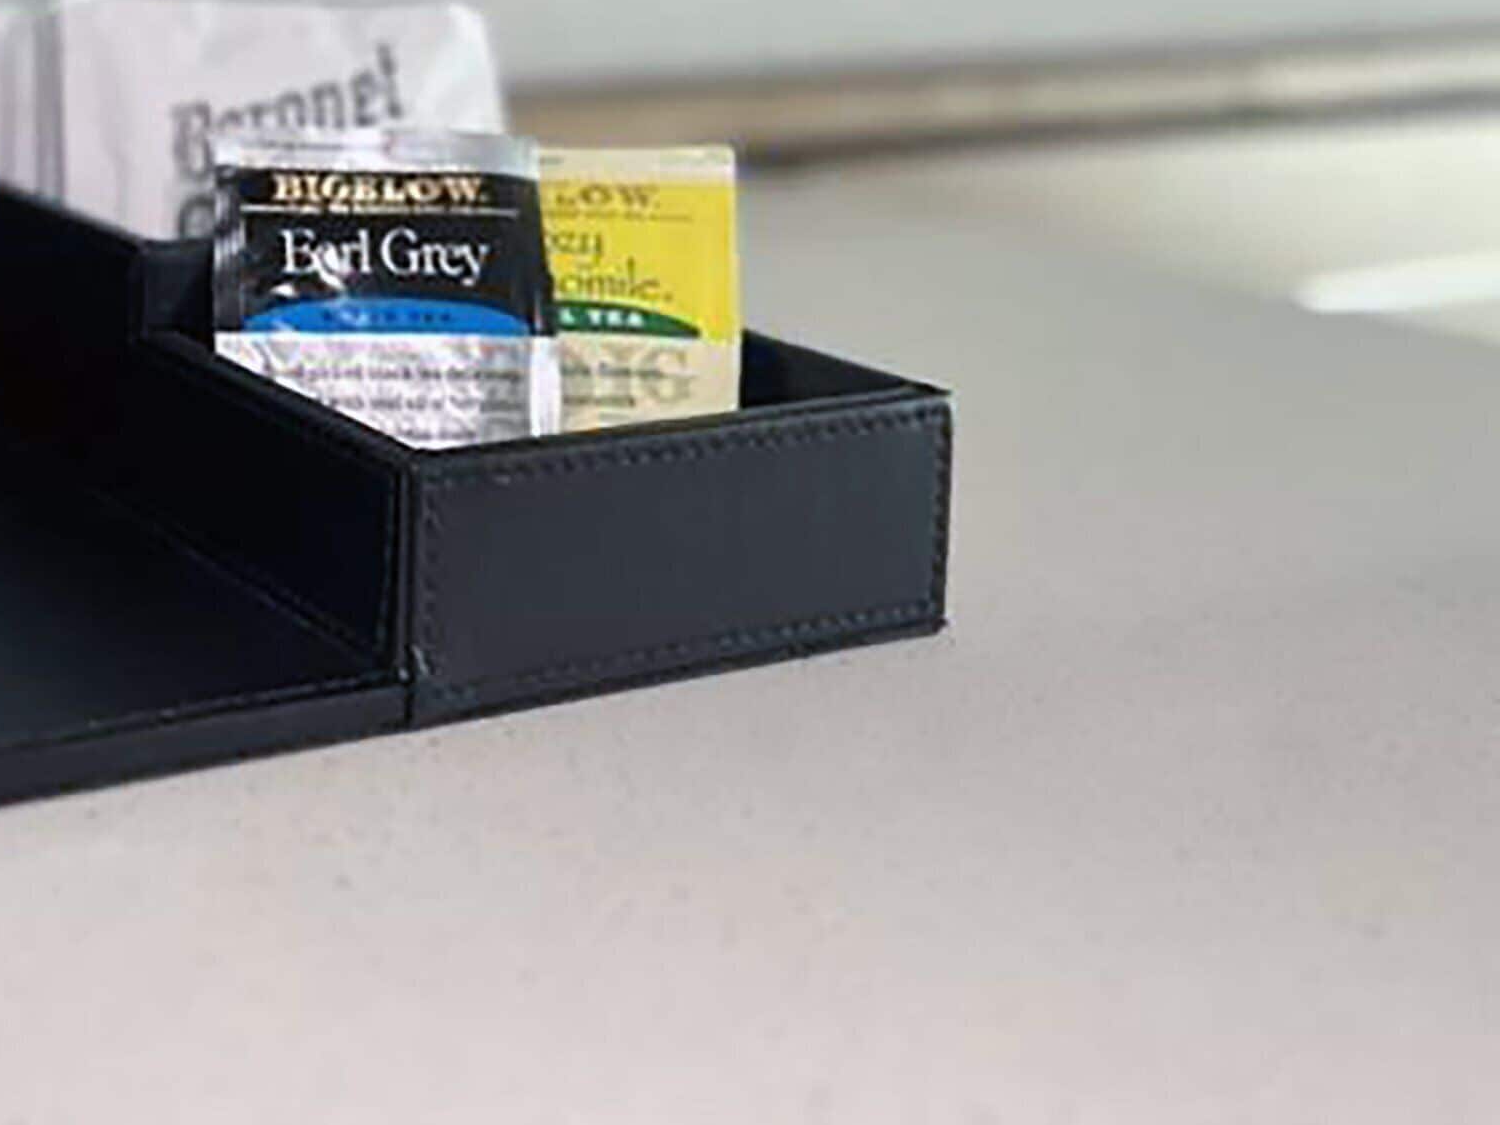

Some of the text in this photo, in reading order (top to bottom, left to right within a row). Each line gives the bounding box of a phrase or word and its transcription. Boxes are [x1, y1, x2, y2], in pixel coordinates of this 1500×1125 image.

[274, 173, 482, 203] BIGELOW
[280, 226, 490, 287] Earl Grey
